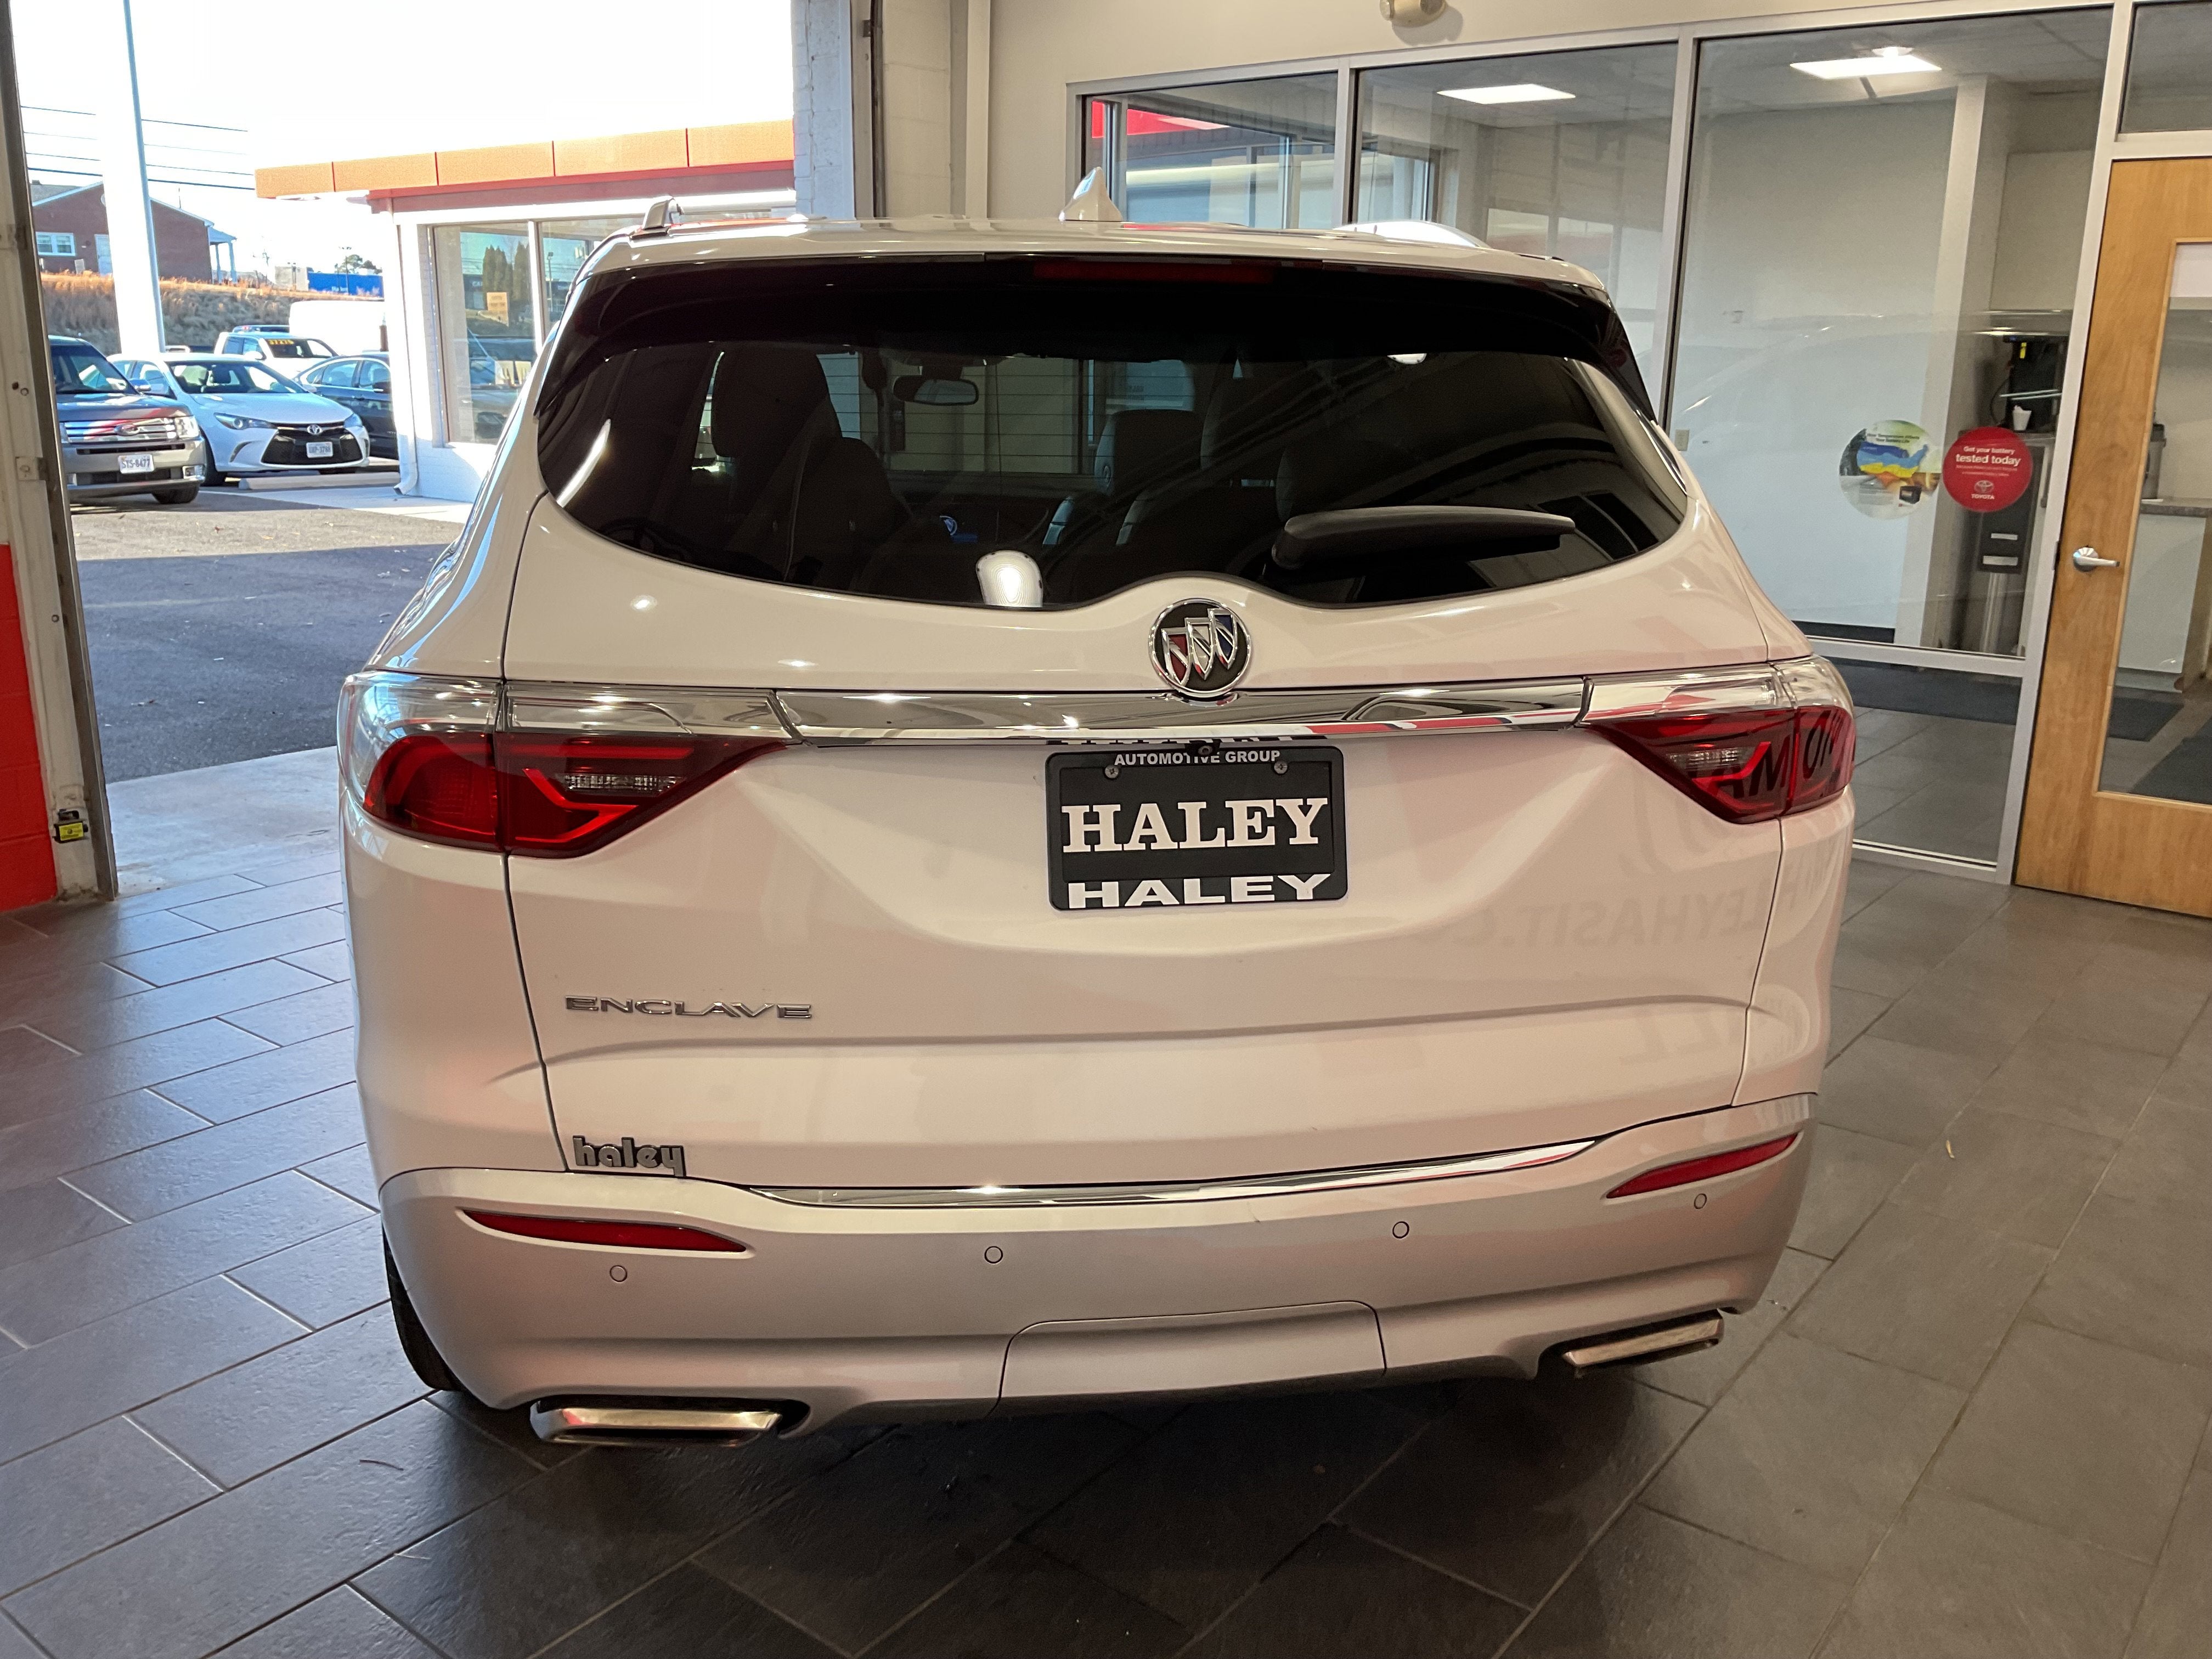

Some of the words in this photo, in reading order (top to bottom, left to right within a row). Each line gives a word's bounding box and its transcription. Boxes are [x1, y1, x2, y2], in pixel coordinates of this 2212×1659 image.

[1955, 454, 1989, 463] tested
[1991, 455, 2021, 467] today
[1224, 750, 1280, 763] GROUP
[1062, 797, 1329, 853] HALEY
[1068, 873, 1331, 909] HALEY
[565, 995, 812, 1019] ENCLAVE
[573, 1135, 686, 1177] haley
